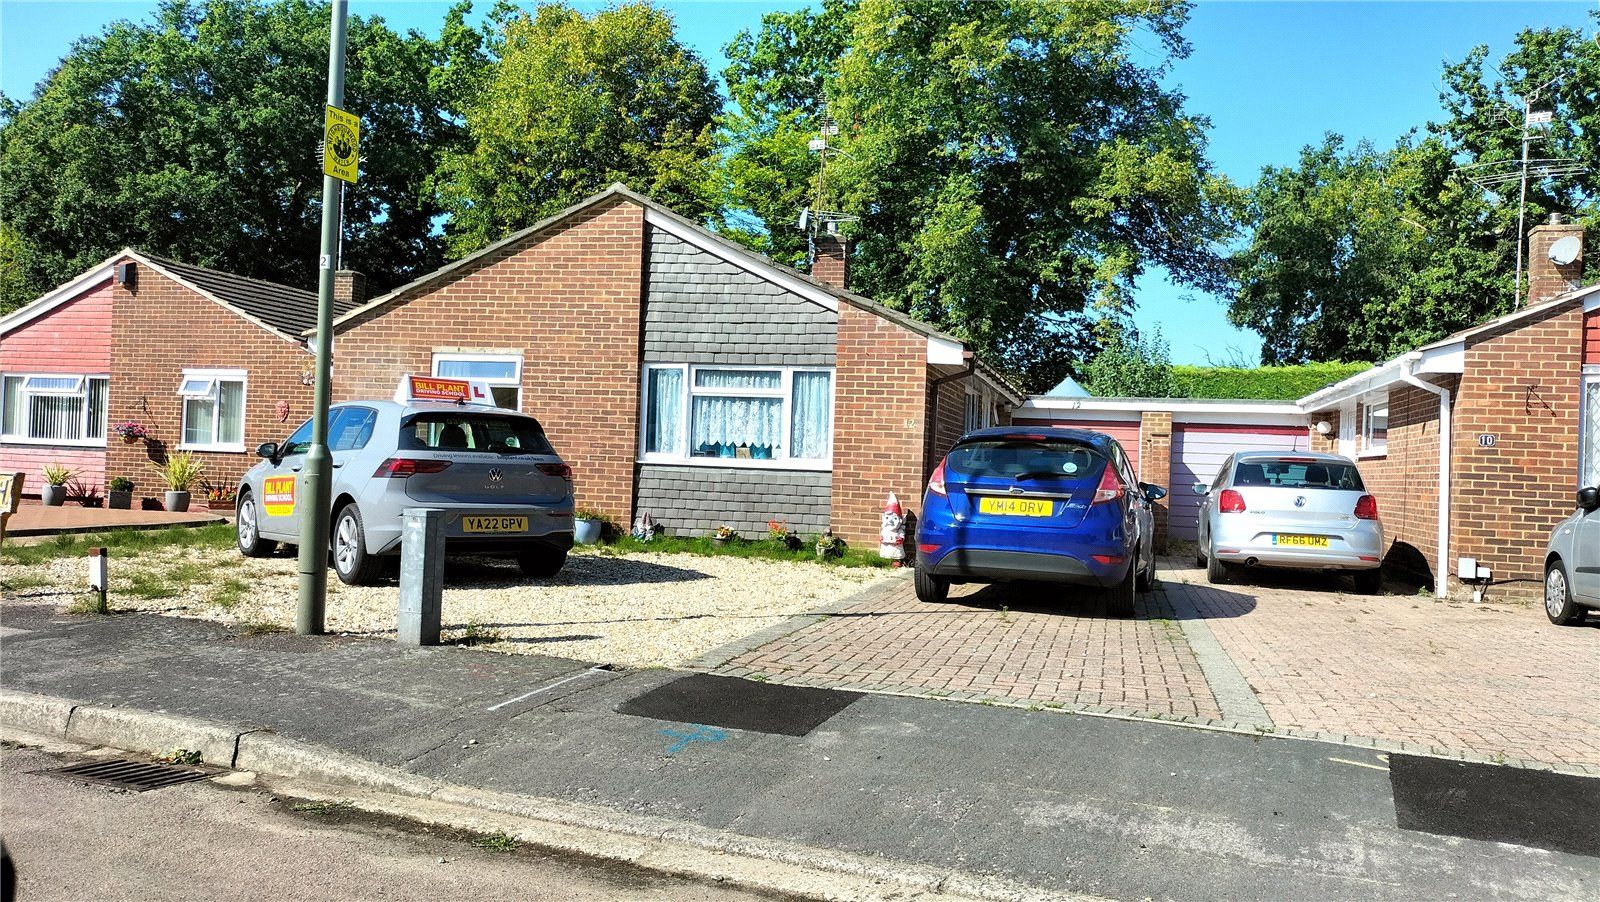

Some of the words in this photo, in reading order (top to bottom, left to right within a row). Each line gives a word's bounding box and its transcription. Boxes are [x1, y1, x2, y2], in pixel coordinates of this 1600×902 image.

[329, 110, 344, 122] This
[346, 116, 352, 125] is
[333, 165, 350, 178] Area
[415, 381, 434, 390] BILL
[436, 383, 465, 393] PLANT
[473, 386, 485, 398] L
[1481, 435, 1493, 446] 10
[265, 482, 276, 495] BILL
[276, 480, 294, 494] PLANT
[989, 500, 1015, 511] YM14
[1020, 501, 1044, 513] ORV
[468, 518, 499, 530] YA22
[502, 518, 523, 529] GPV
[1280, 535, 1306, 545] RF66
[1308, 536, 1328, 547] UMZ
